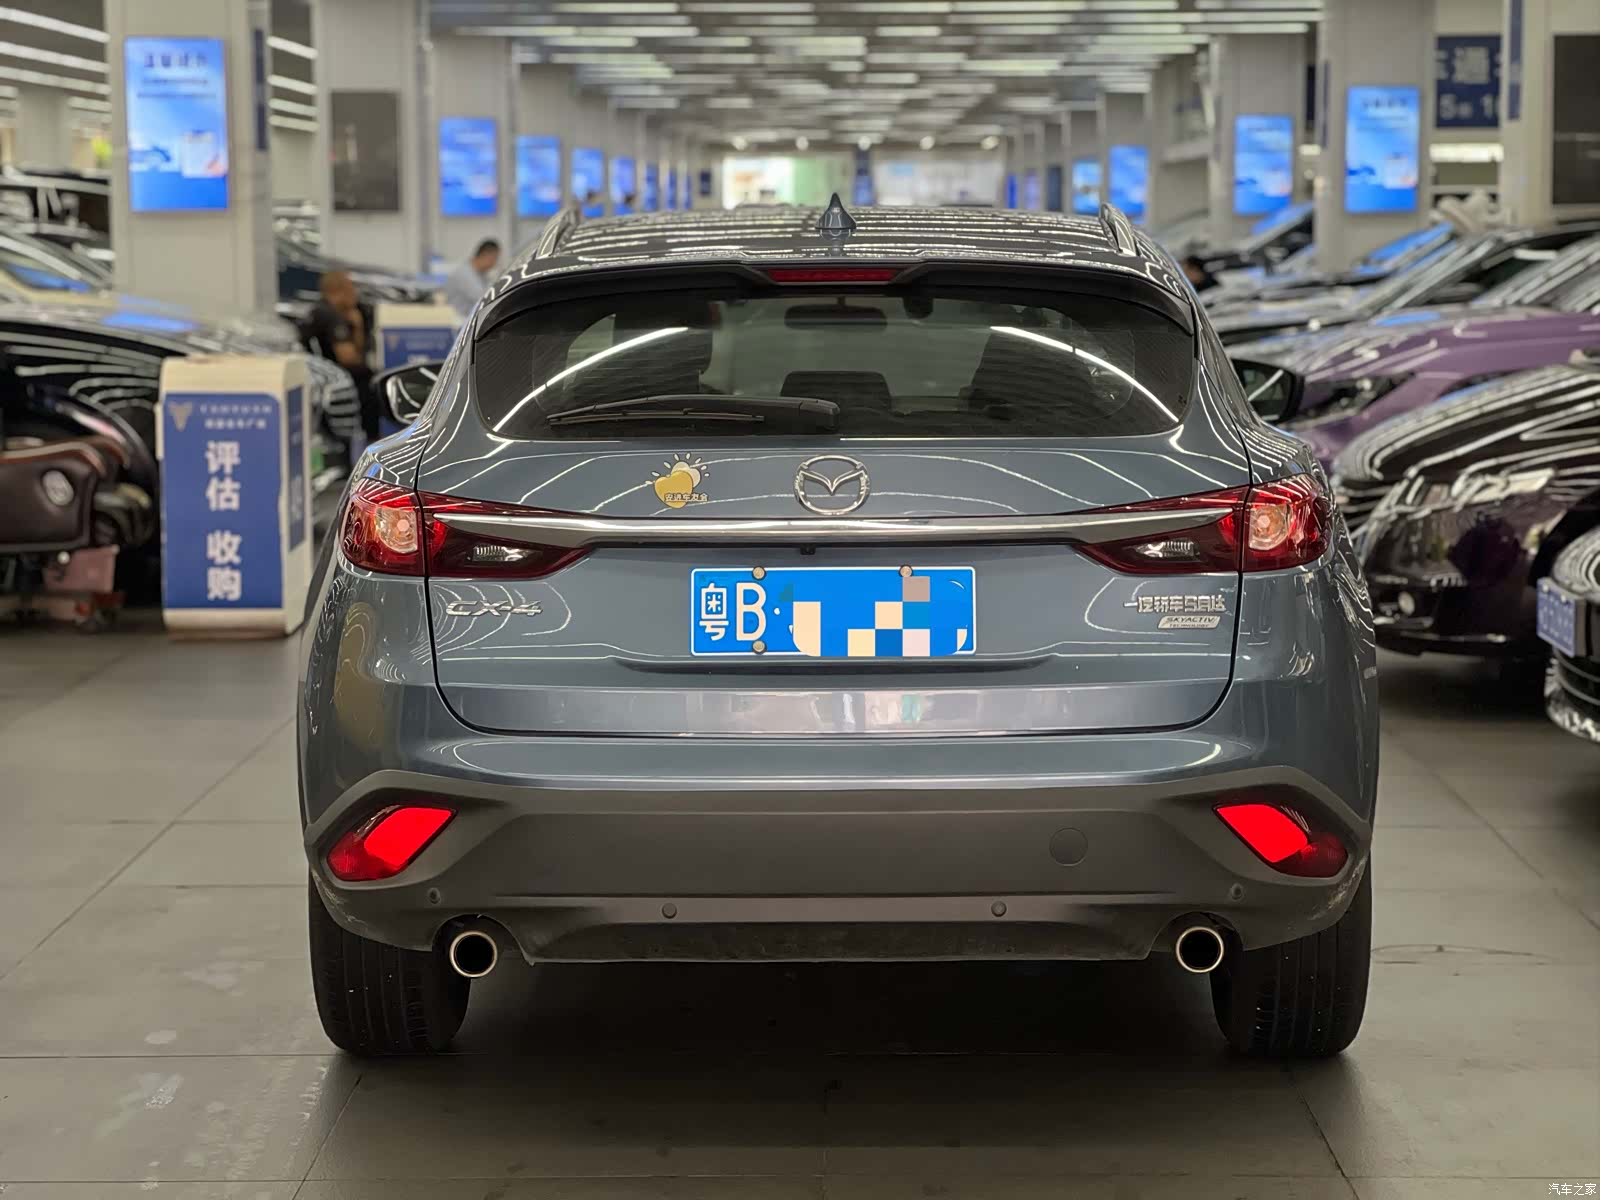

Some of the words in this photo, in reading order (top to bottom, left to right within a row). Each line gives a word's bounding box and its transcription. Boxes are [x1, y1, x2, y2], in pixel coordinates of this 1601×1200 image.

[205, 441, 241, 511] 评估
[206, 530, 242, 601] 收购
[446, 600, 543, 616] CX-4
[1123, 594, 1226, 613] 一汽轿车马自达
